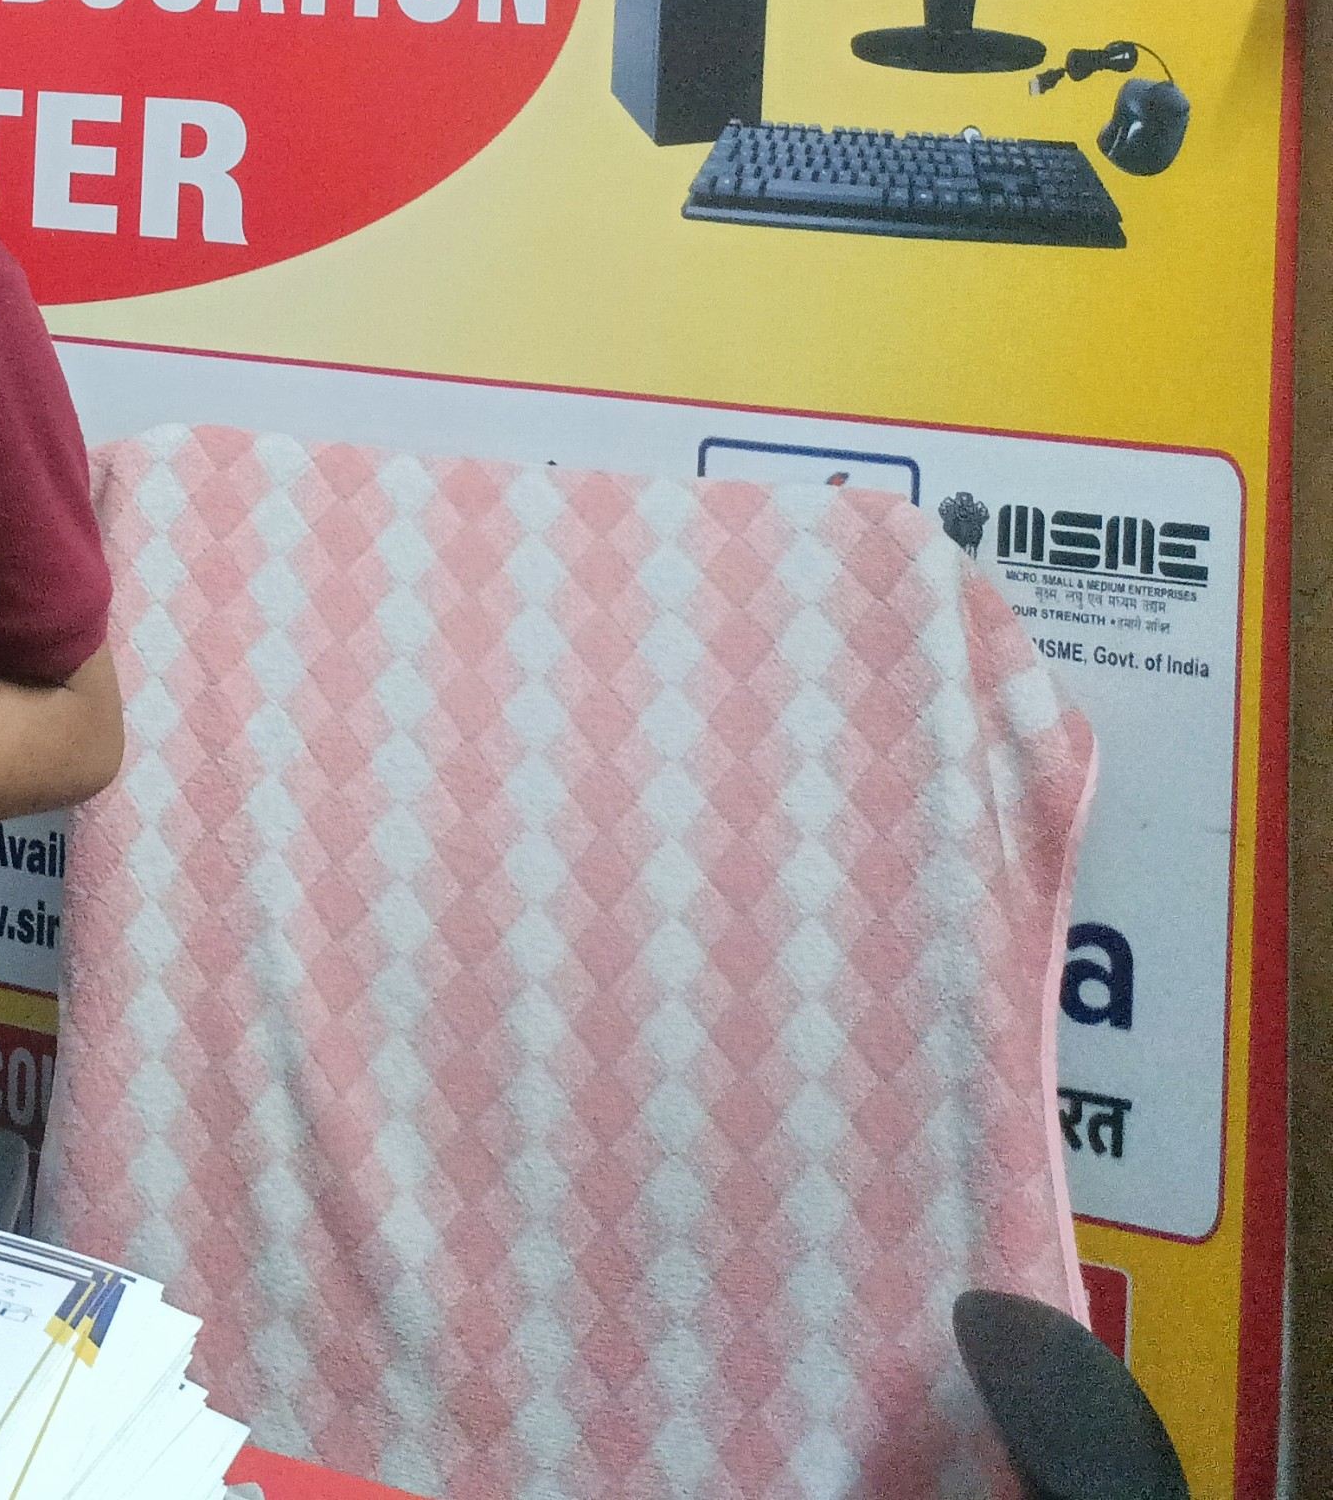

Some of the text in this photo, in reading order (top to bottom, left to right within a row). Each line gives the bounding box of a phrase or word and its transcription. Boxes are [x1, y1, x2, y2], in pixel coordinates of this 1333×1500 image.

[997, 504, 1210, 580] MSME
[1042, 574, 1073, 588] SMALL
[1087, 580, 1125, 594] MEDIUM
[1129, 584, 1196, 601] ENTERPRISES
[1012, 605, 1037, 618] OUR
[1041, 609, 1105, 626] STRENGTH
[1094, 645, 1138, 669] Govt.
[1145, 653, 1162, 671] of
[1168, 655, 1209, 678] India
